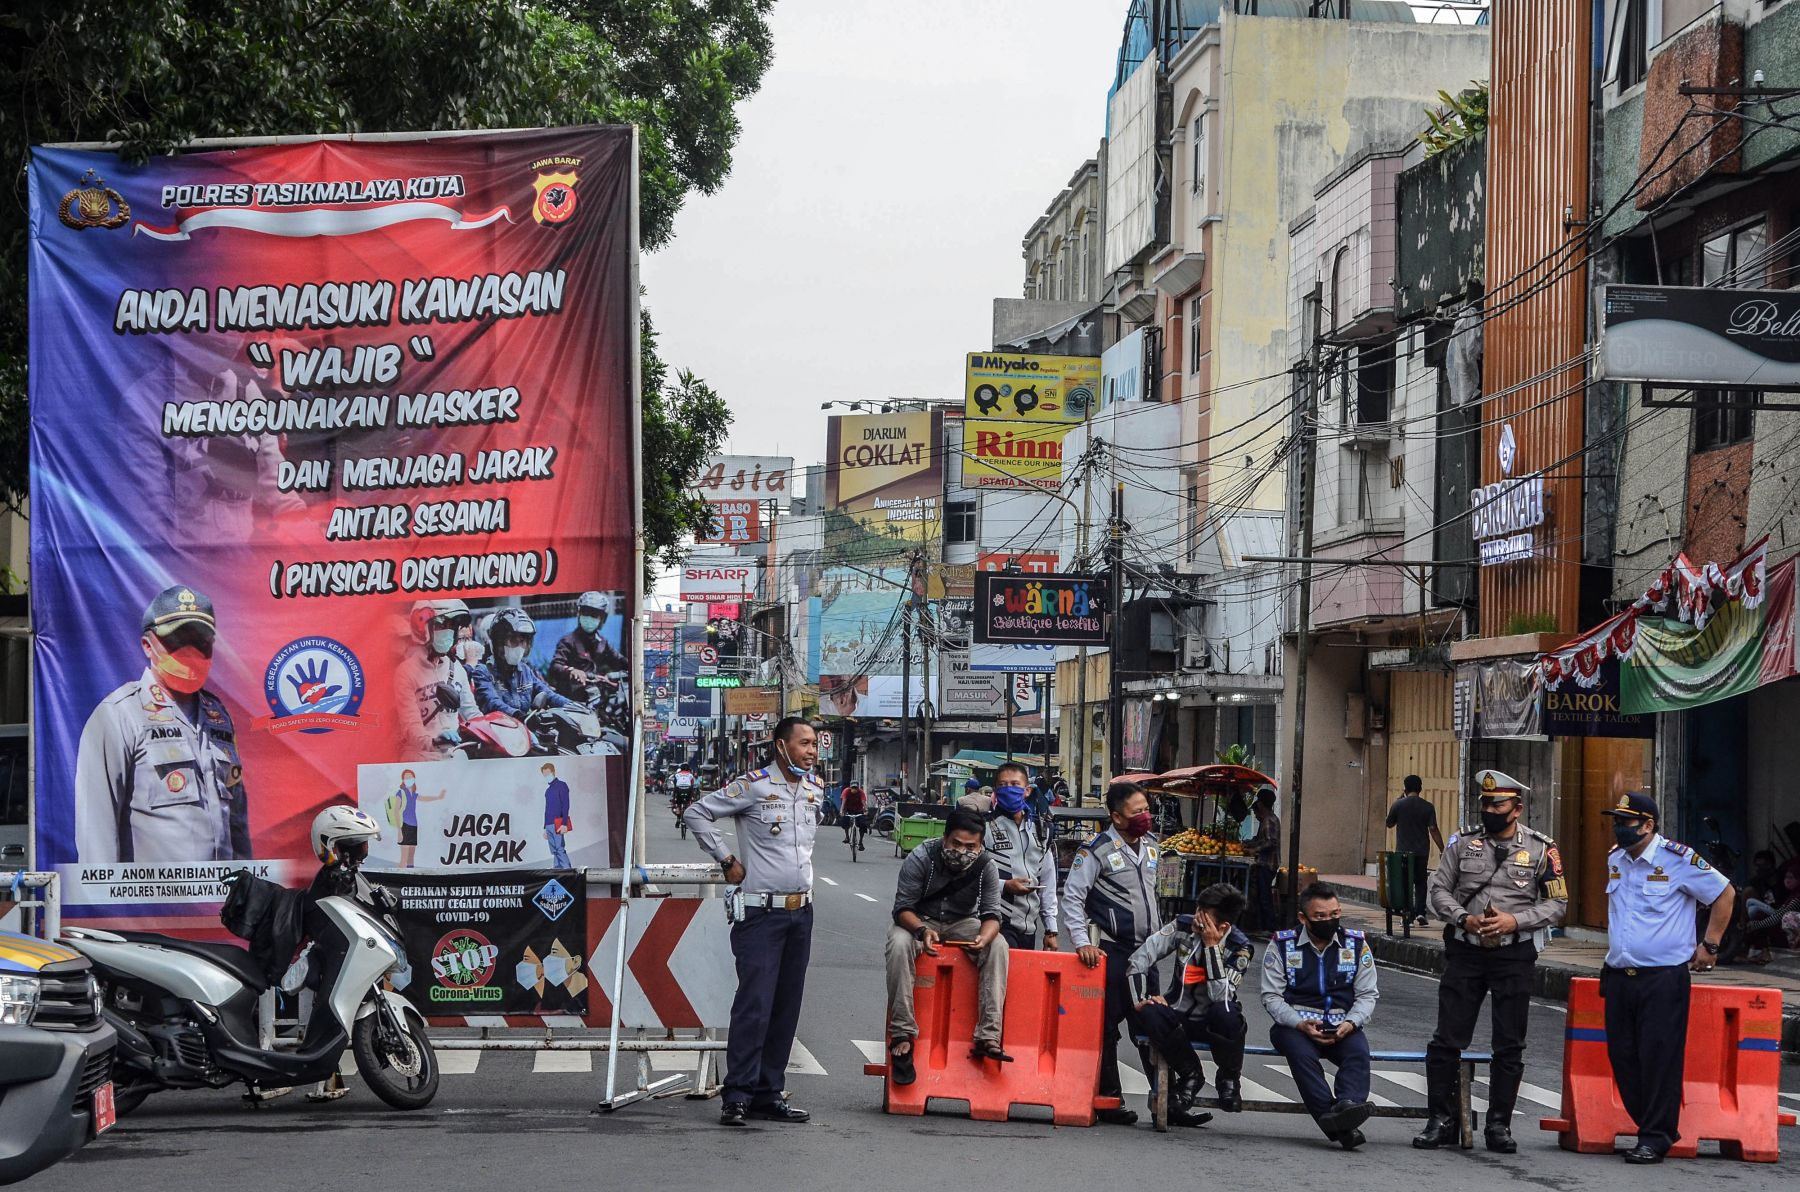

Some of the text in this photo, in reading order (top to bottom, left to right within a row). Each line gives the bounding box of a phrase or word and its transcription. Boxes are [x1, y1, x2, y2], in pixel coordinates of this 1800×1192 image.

[531, 156, 582, 171] JAWA BARAT
[162, 175, 466, 207] POLRES TASIKMALAYA KOTA
[115, 269, 567, 332] ANDA MEMASUKI KAWASAN
[283, 344, 403, 390] WAJIB
[984, 357, 1040, 373] Miyako
[162, 387, 521, 438] MENGGUNAKAN MASKER
[863, 427, 907, 441] DJARUM
[843, 443, 926, 467] COKLAT
[277, 446, 556, 492] DAN MENJAGA JARAK
[700, 462, 787, 492] Asia
[980, 478, 1015, 486] ISTANA
[722, 503, 751, 514] BASO
[887, 509, 935, 521] INDONESIA
[326, 499, 509, 541] ANTAR SESAMA
[286, 561, 396, 596] PHYSICAL
[401, 551, 541, 592] DISTANCING
[685, 569, 749, 580] SHARP
[267, 639, 362, 691] KESELAMATAN UNTUK KEMANUSIAAN
[853, 648, 893, 666] Kaah
[696, 678, 740, 688] SEMPANA
[1547, 693, 1620, 711] BAROK
[1552, 712, 1641, 724] TEXTILE & TAILOR
[151, 728, 183, 739] ANOM
[443, 813, 510, 837] JAGA
[440, 840, 527, 865] JARAK
[81, 869, 115, 881] AKBP
[122, 868, 156, 880] ANOM
[158, 867, 231, 880] KARIBIANTO
[110, 884, 231, 897] KAPOLRES TASIKMALAYA KO
[401, 885, 525, 897] GERAKAN SEJUTA MASKER
[402, 898, 523, 910] BERSATU CEGAH CORONA
[435, 912, 490, 923] (COVID-19)
[431, 944, 499, 979] STOP
[432, 987, 501, 1000] Corona-Virus
